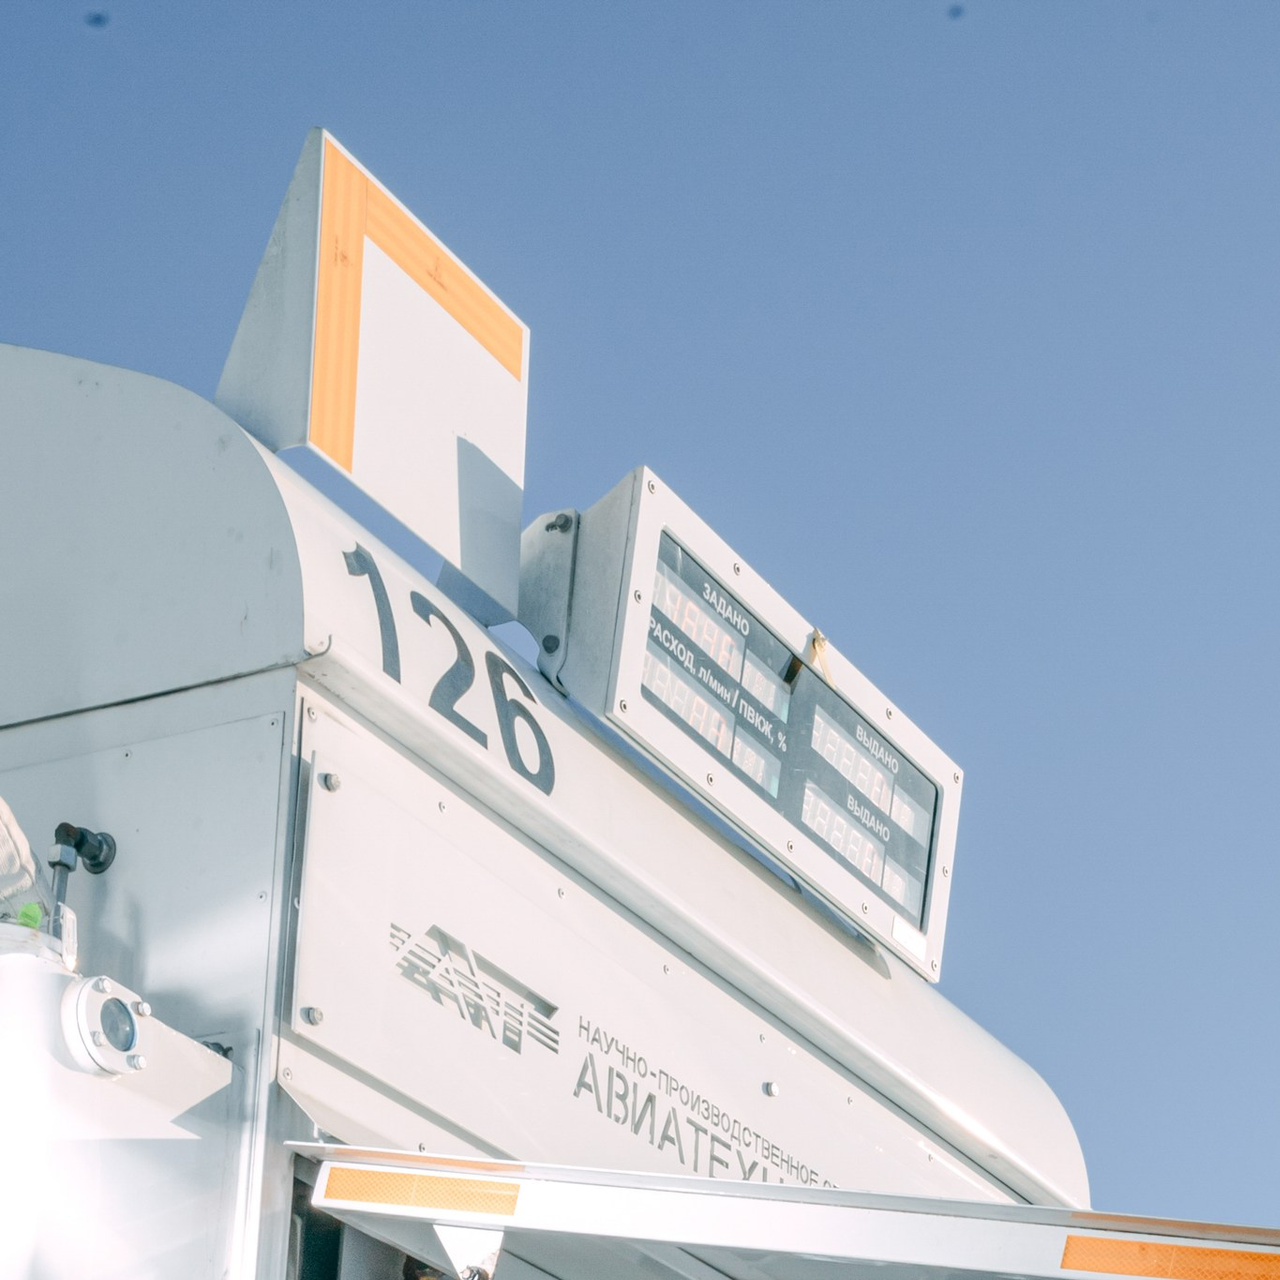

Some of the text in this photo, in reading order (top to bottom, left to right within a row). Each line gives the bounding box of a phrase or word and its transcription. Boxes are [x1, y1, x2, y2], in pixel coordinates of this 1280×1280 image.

[702, 582, 750, 637] ЗАДАНО
[341, 541, 556, 797] 126
[855, 725, 899, 775] ВЫДАНО
[846, 794, 891, 843] ВЫДАНО
[572, 1051, 784, 1184] АВИАТЕХ
[578, 1015, 819, 1187] НАУЧНО-ПРОИЗВОДСТВЕННОЕ
